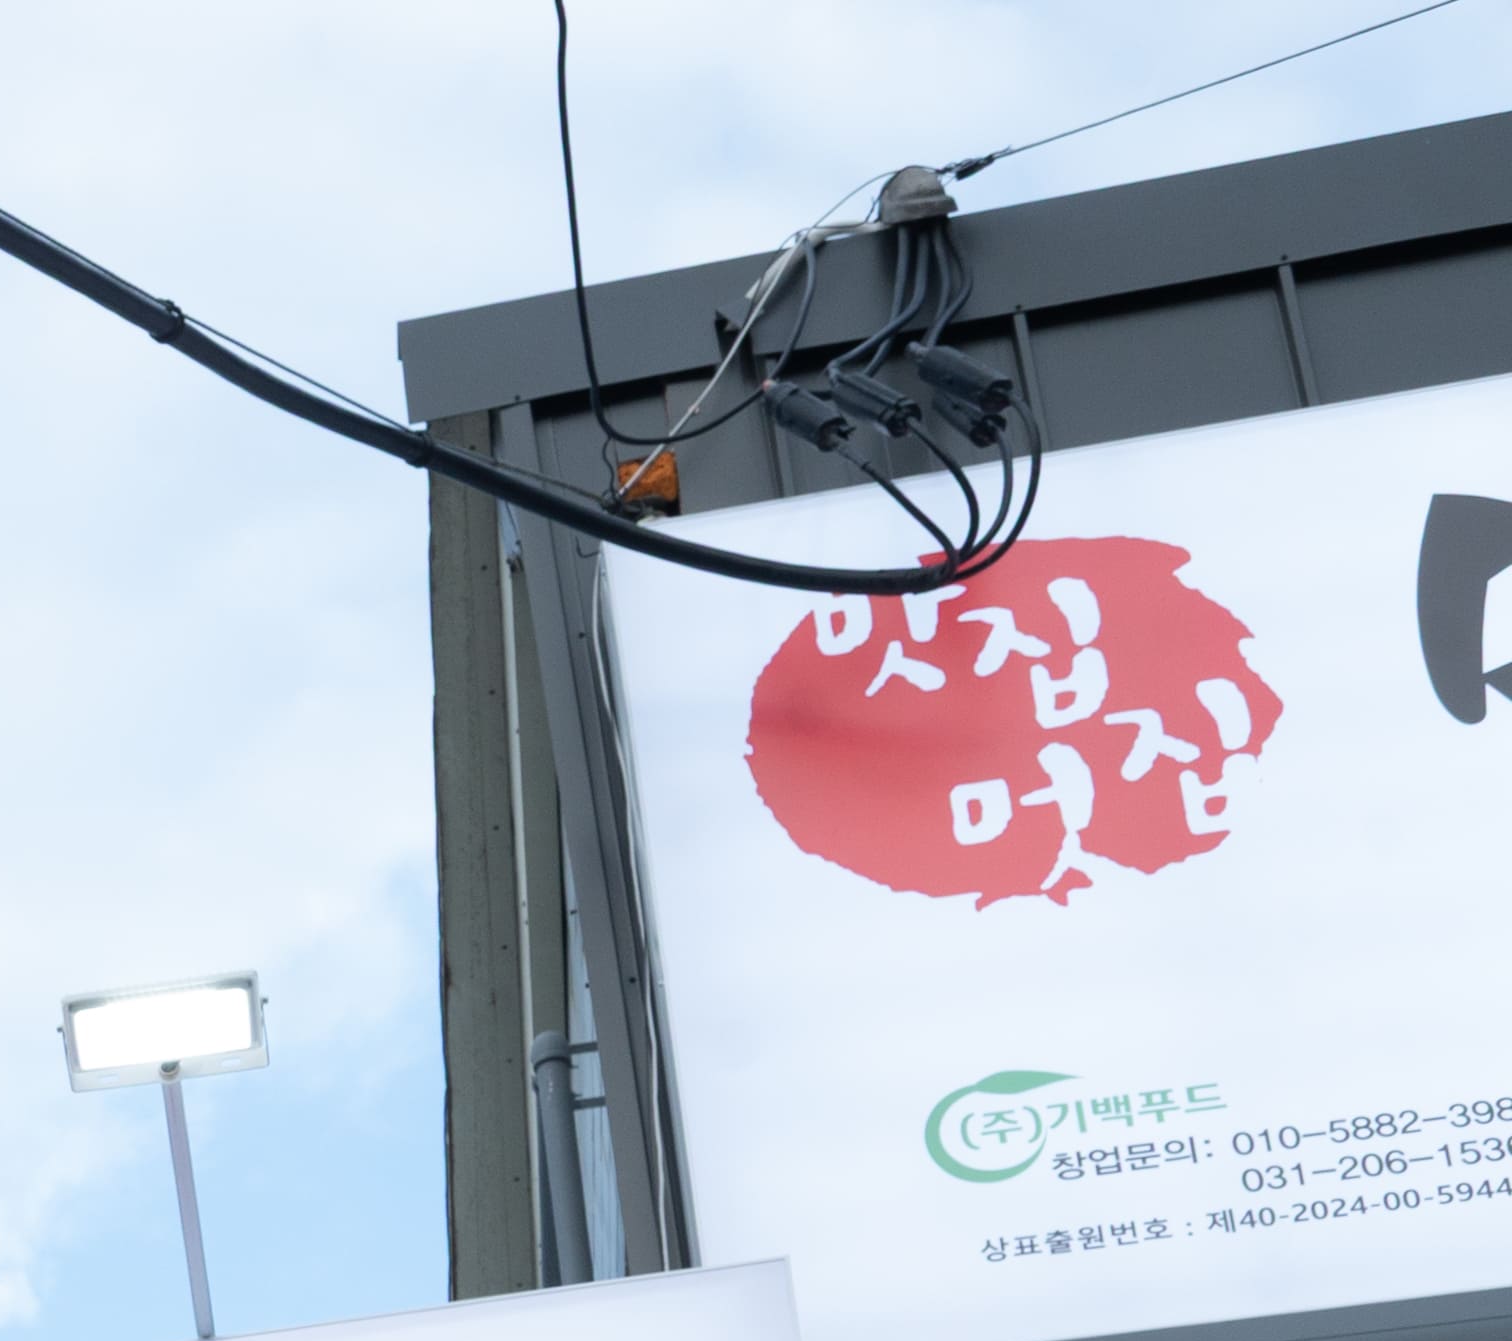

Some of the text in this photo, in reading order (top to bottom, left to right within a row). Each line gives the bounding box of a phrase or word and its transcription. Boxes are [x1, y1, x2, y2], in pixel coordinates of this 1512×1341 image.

[960, 1083, 1228, 1151] (주)기백푸드
[1052, 1135, 1214, 1181] 창업문의:
[1242, 1136, 1512, 1192] 031-206-153
[981, 1217, 1173, 1263] 상표출원번호
